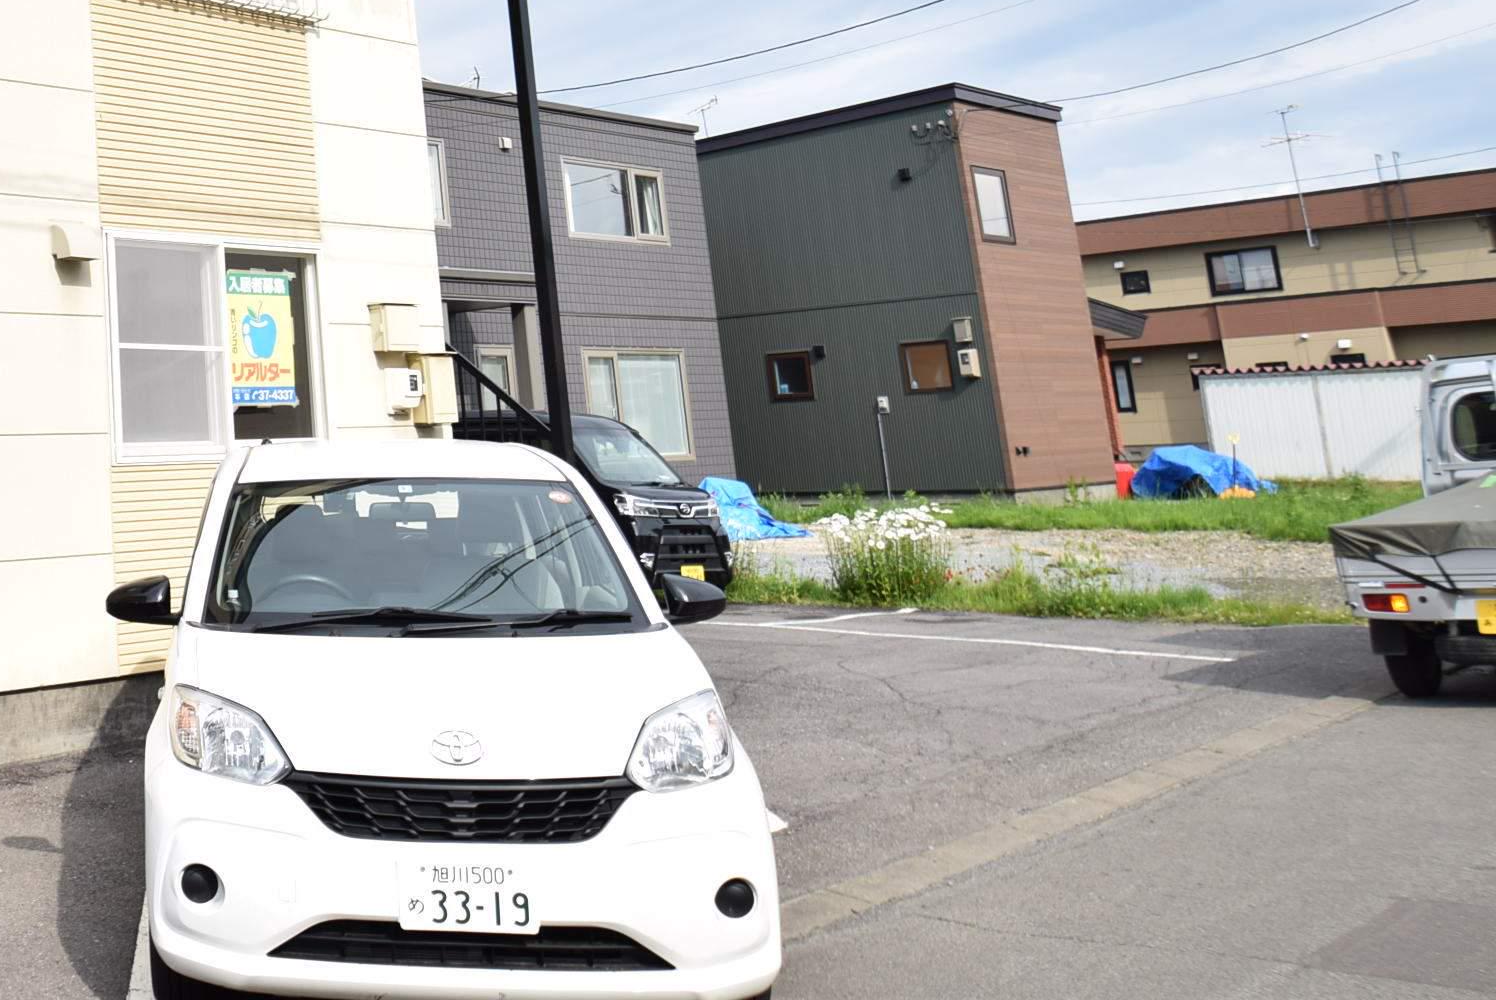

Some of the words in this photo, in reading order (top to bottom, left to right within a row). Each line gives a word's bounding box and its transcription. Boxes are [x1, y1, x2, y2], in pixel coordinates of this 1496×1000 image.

[232, 362, 291, 382] リアルター
[408, 897, 425, 914] め
[431, 889, 530, 927] 33-19
